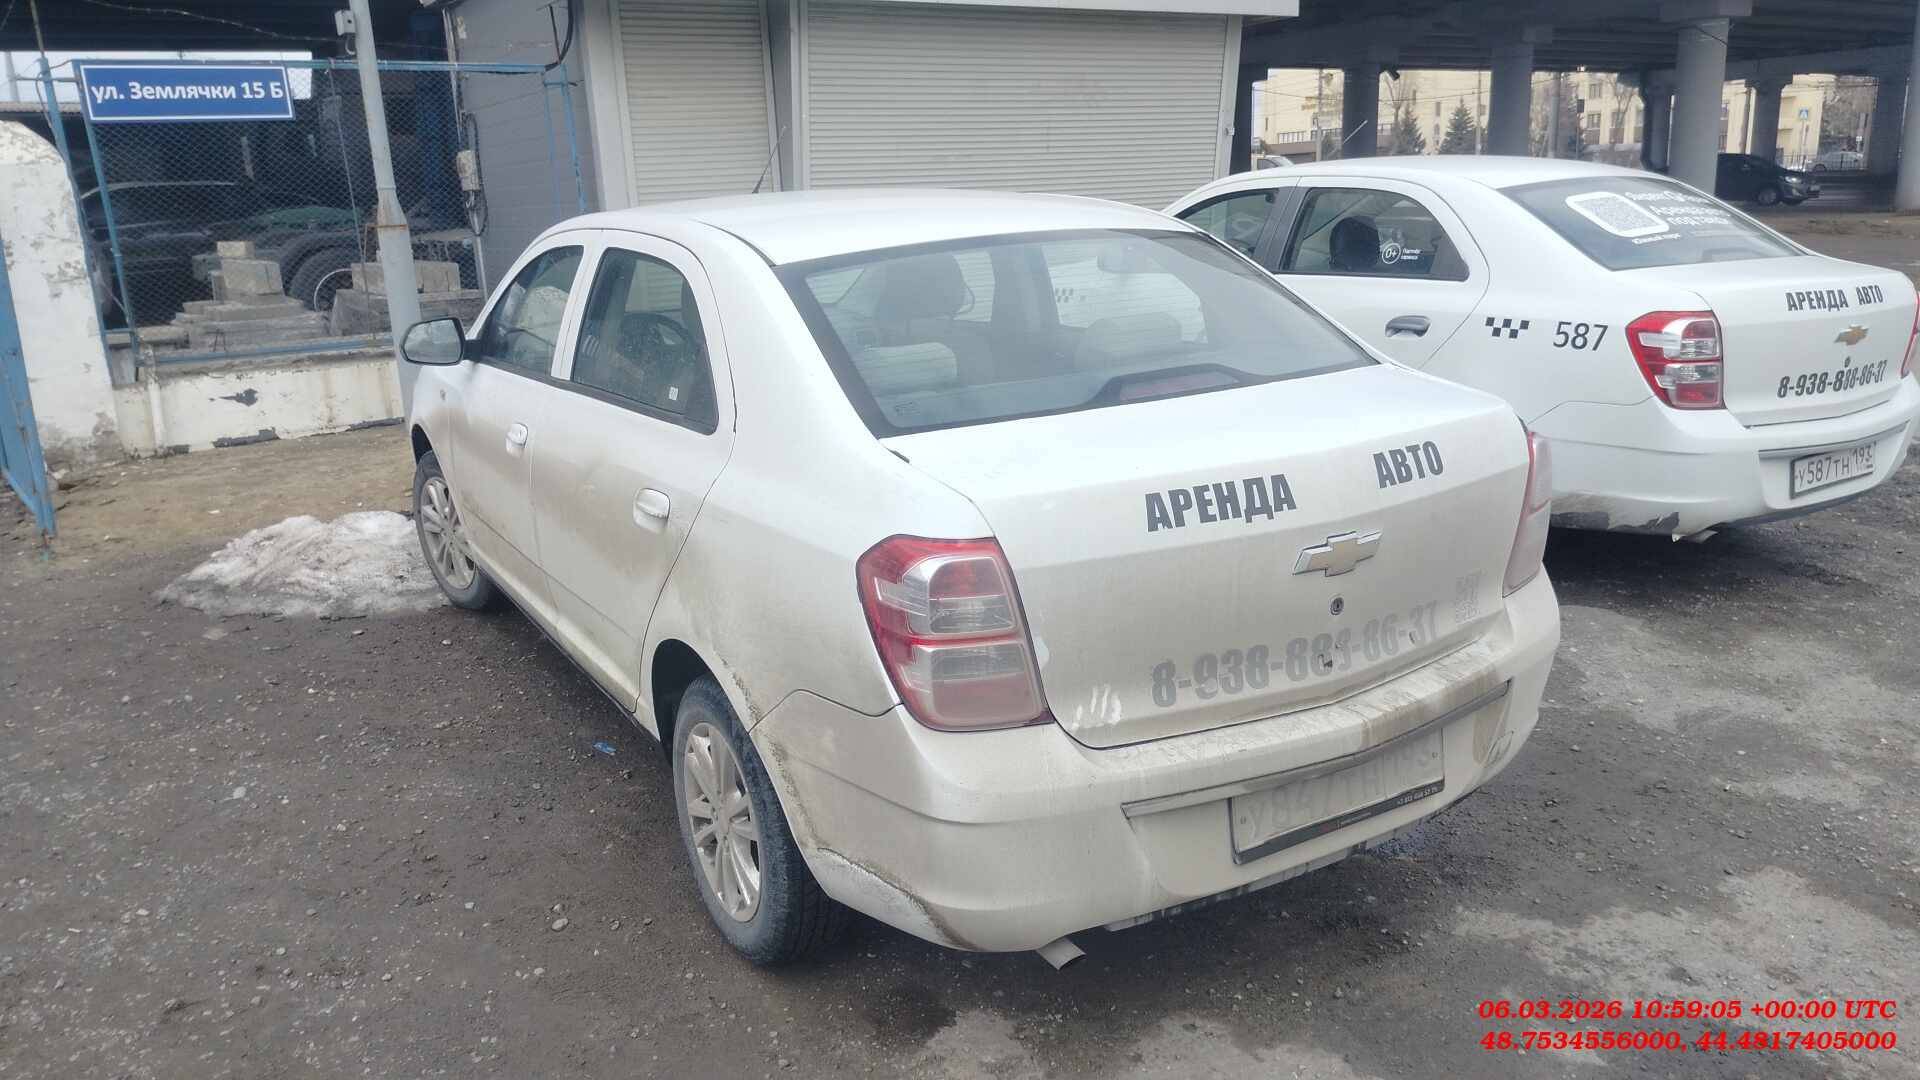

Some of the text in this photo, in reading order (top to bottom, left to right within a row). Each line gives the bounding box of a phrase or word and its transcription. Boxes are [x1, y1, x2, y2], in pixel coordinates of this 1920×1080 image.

[91, 81, 284, 103] ул. Землячки 15 Б
[1785, 284, 1884, 312] АРЕНДА АВТО
[1553, 321, 1609, 351] 587
[1145, 440, 1444, 532] АРЕНДА АВТО
